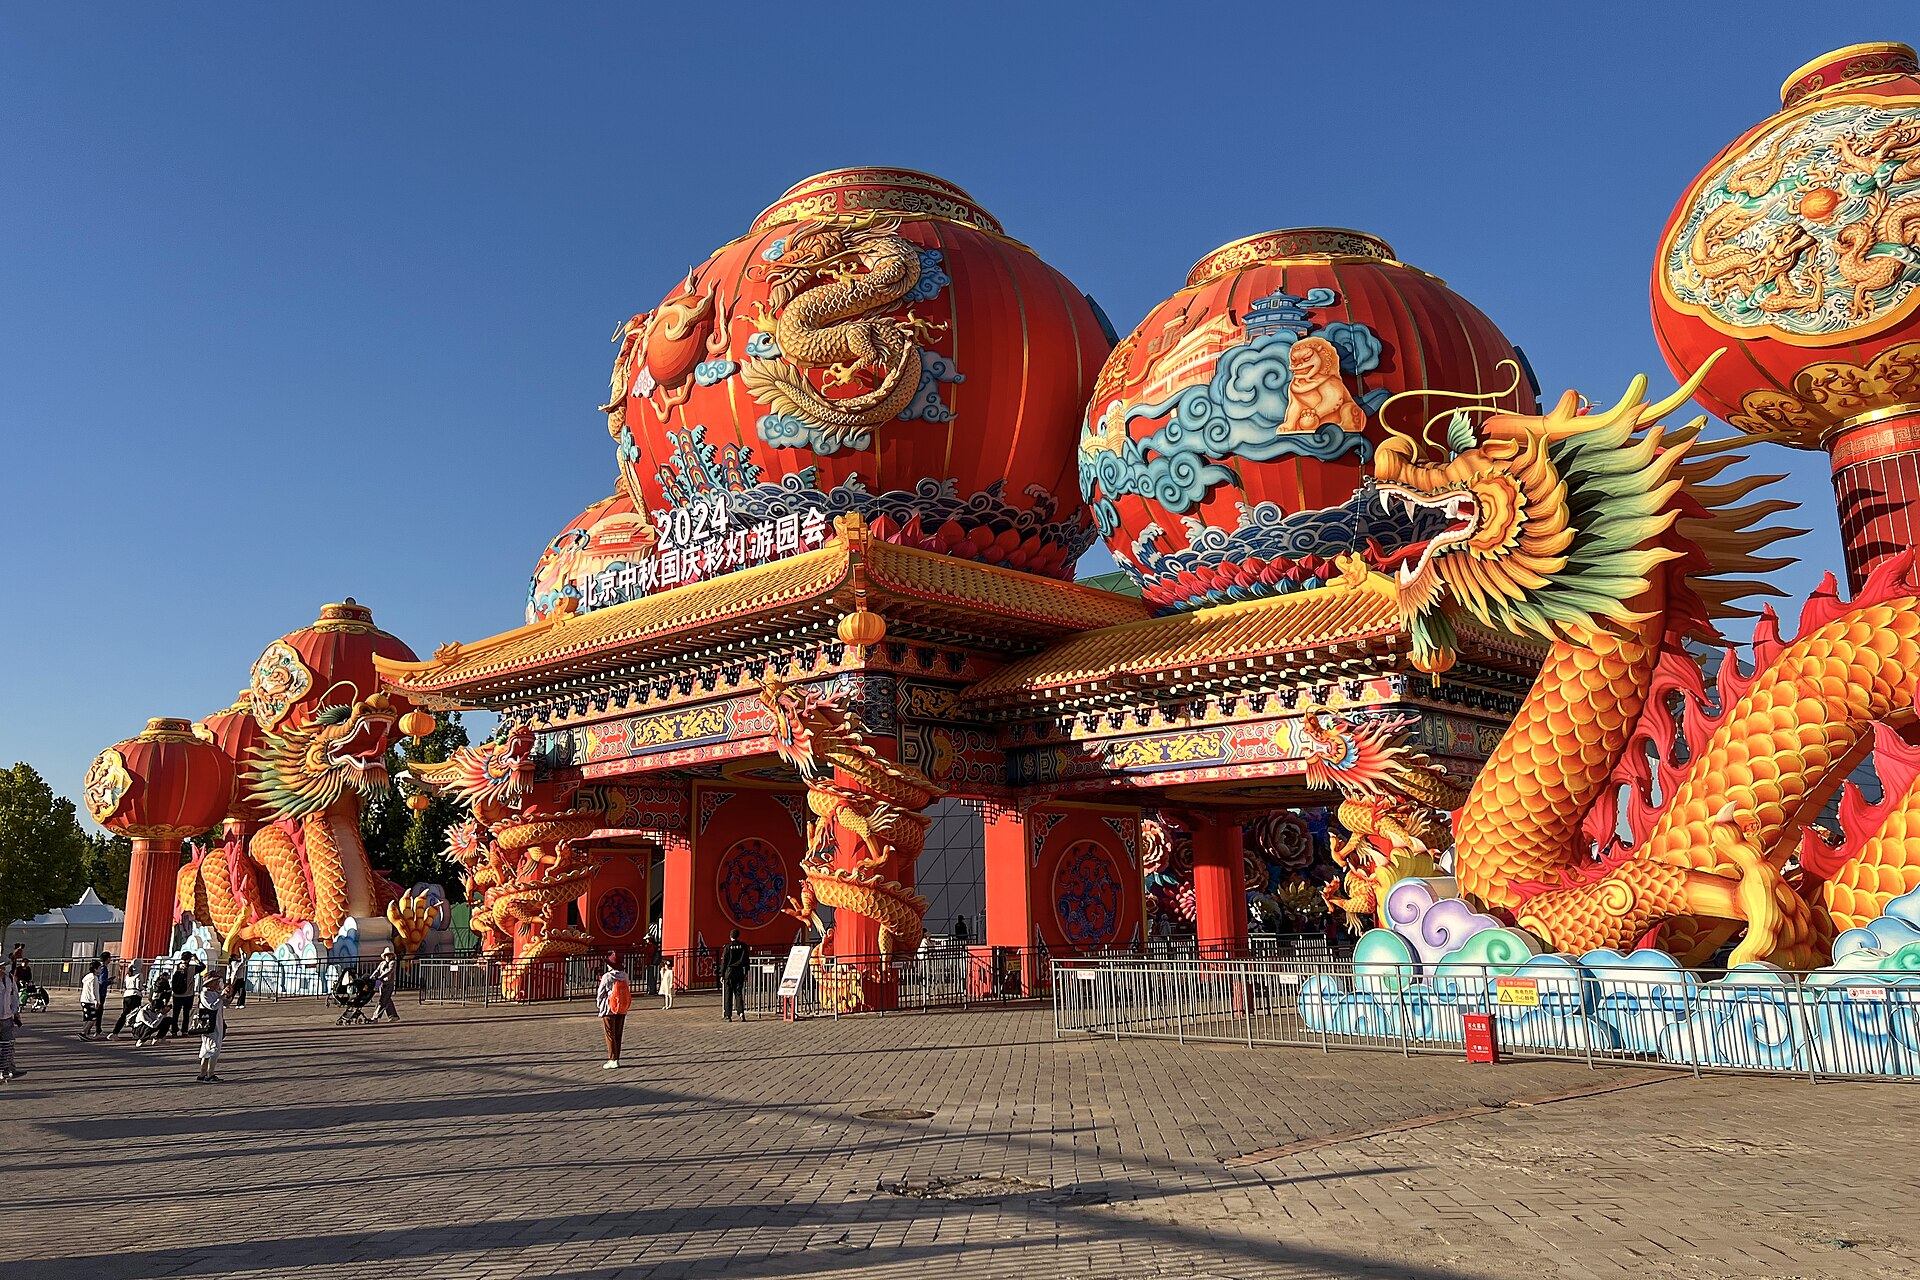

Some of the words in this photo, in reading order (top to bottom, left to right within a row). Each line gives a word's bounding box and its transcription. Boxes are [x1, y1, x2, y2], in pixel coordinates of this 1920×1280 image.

[579, 507, 826, 607] 北京中秋国庆彩灯游园会
[657, 497, 729, 550] 2024
